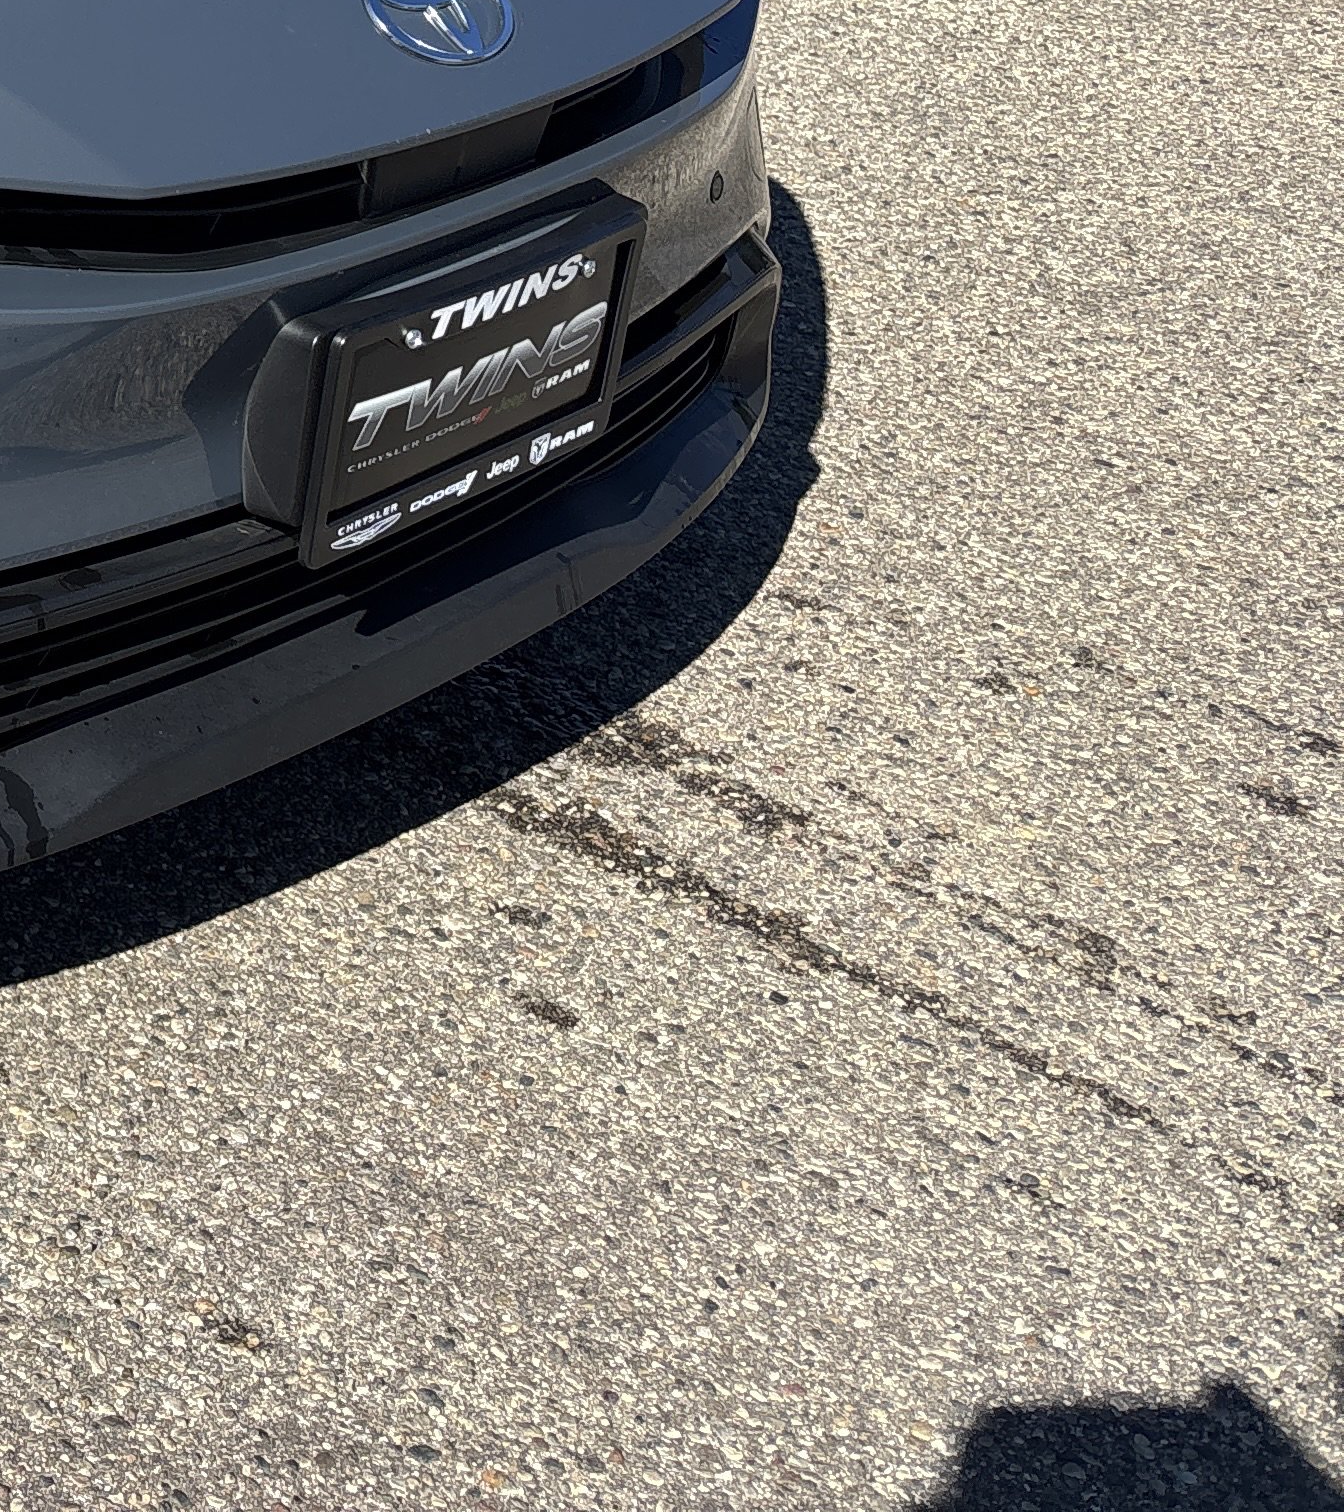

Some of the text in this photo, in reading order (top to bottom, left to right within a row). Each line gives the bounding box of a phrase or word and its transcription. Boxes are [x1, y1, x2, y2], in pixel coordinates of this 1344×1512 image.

[430, 252, 584, 339] TWINS
[347, 300, 608, 451] TWINS
[347, 439, 420, 473] CHRYSLER
[544, 358, 591, 389] RAM
[337, 502, 399, 537] CHRYSLER
[486, 454, 520, 479] Jeep
[549, 420, 595, 451] RAM
